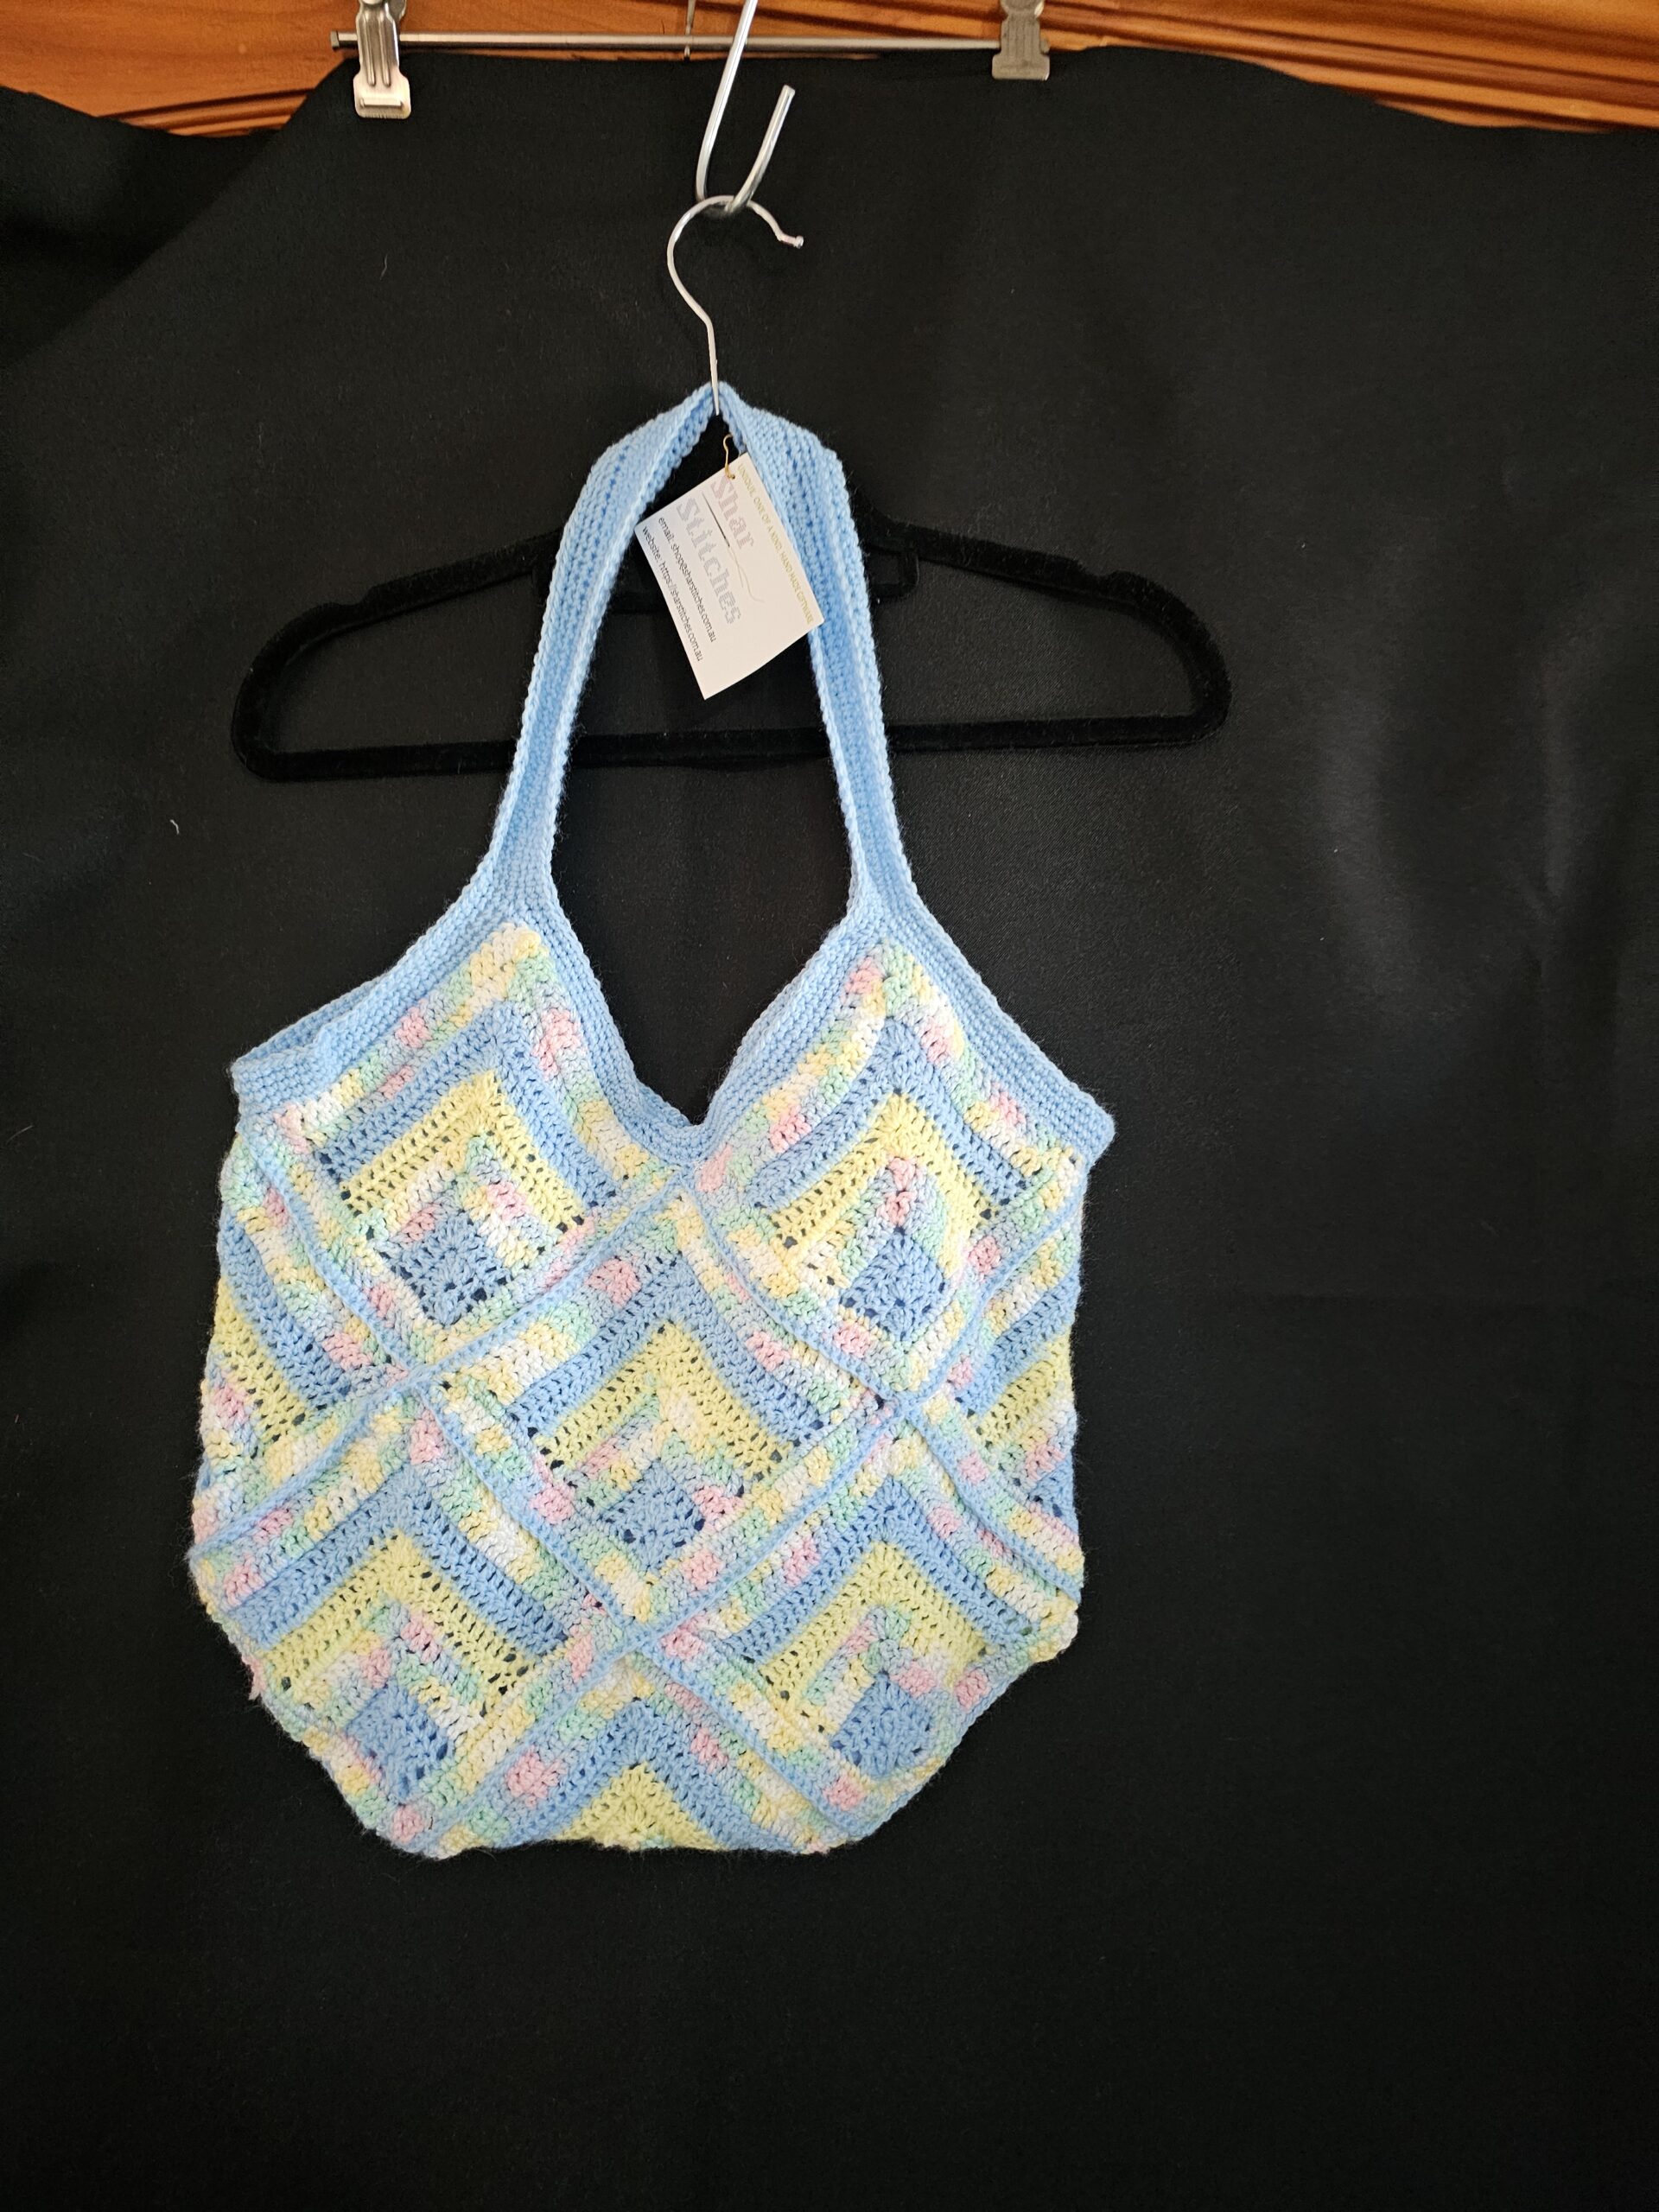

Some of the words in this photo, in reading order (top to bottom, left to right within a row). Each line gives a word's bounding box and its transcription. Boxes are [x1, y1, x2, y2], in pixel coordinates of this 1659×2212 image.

[676, 497, 742, 625] Stitches
[710, 474, 753, 550] Shar
[752, 496, 765, 514] ONE
[760, 512, 771, 525] OF
[779, 550, 793, 574] HAND
[787, 571, 801, 593] MADE
[642, 526, 662, 563] website:
[658, 561, 703, 662] https://sharstitches.com.au
[658, 517, 675, 543] email:
[671, 543, 717, 642] shop@sharstitches.com.au
